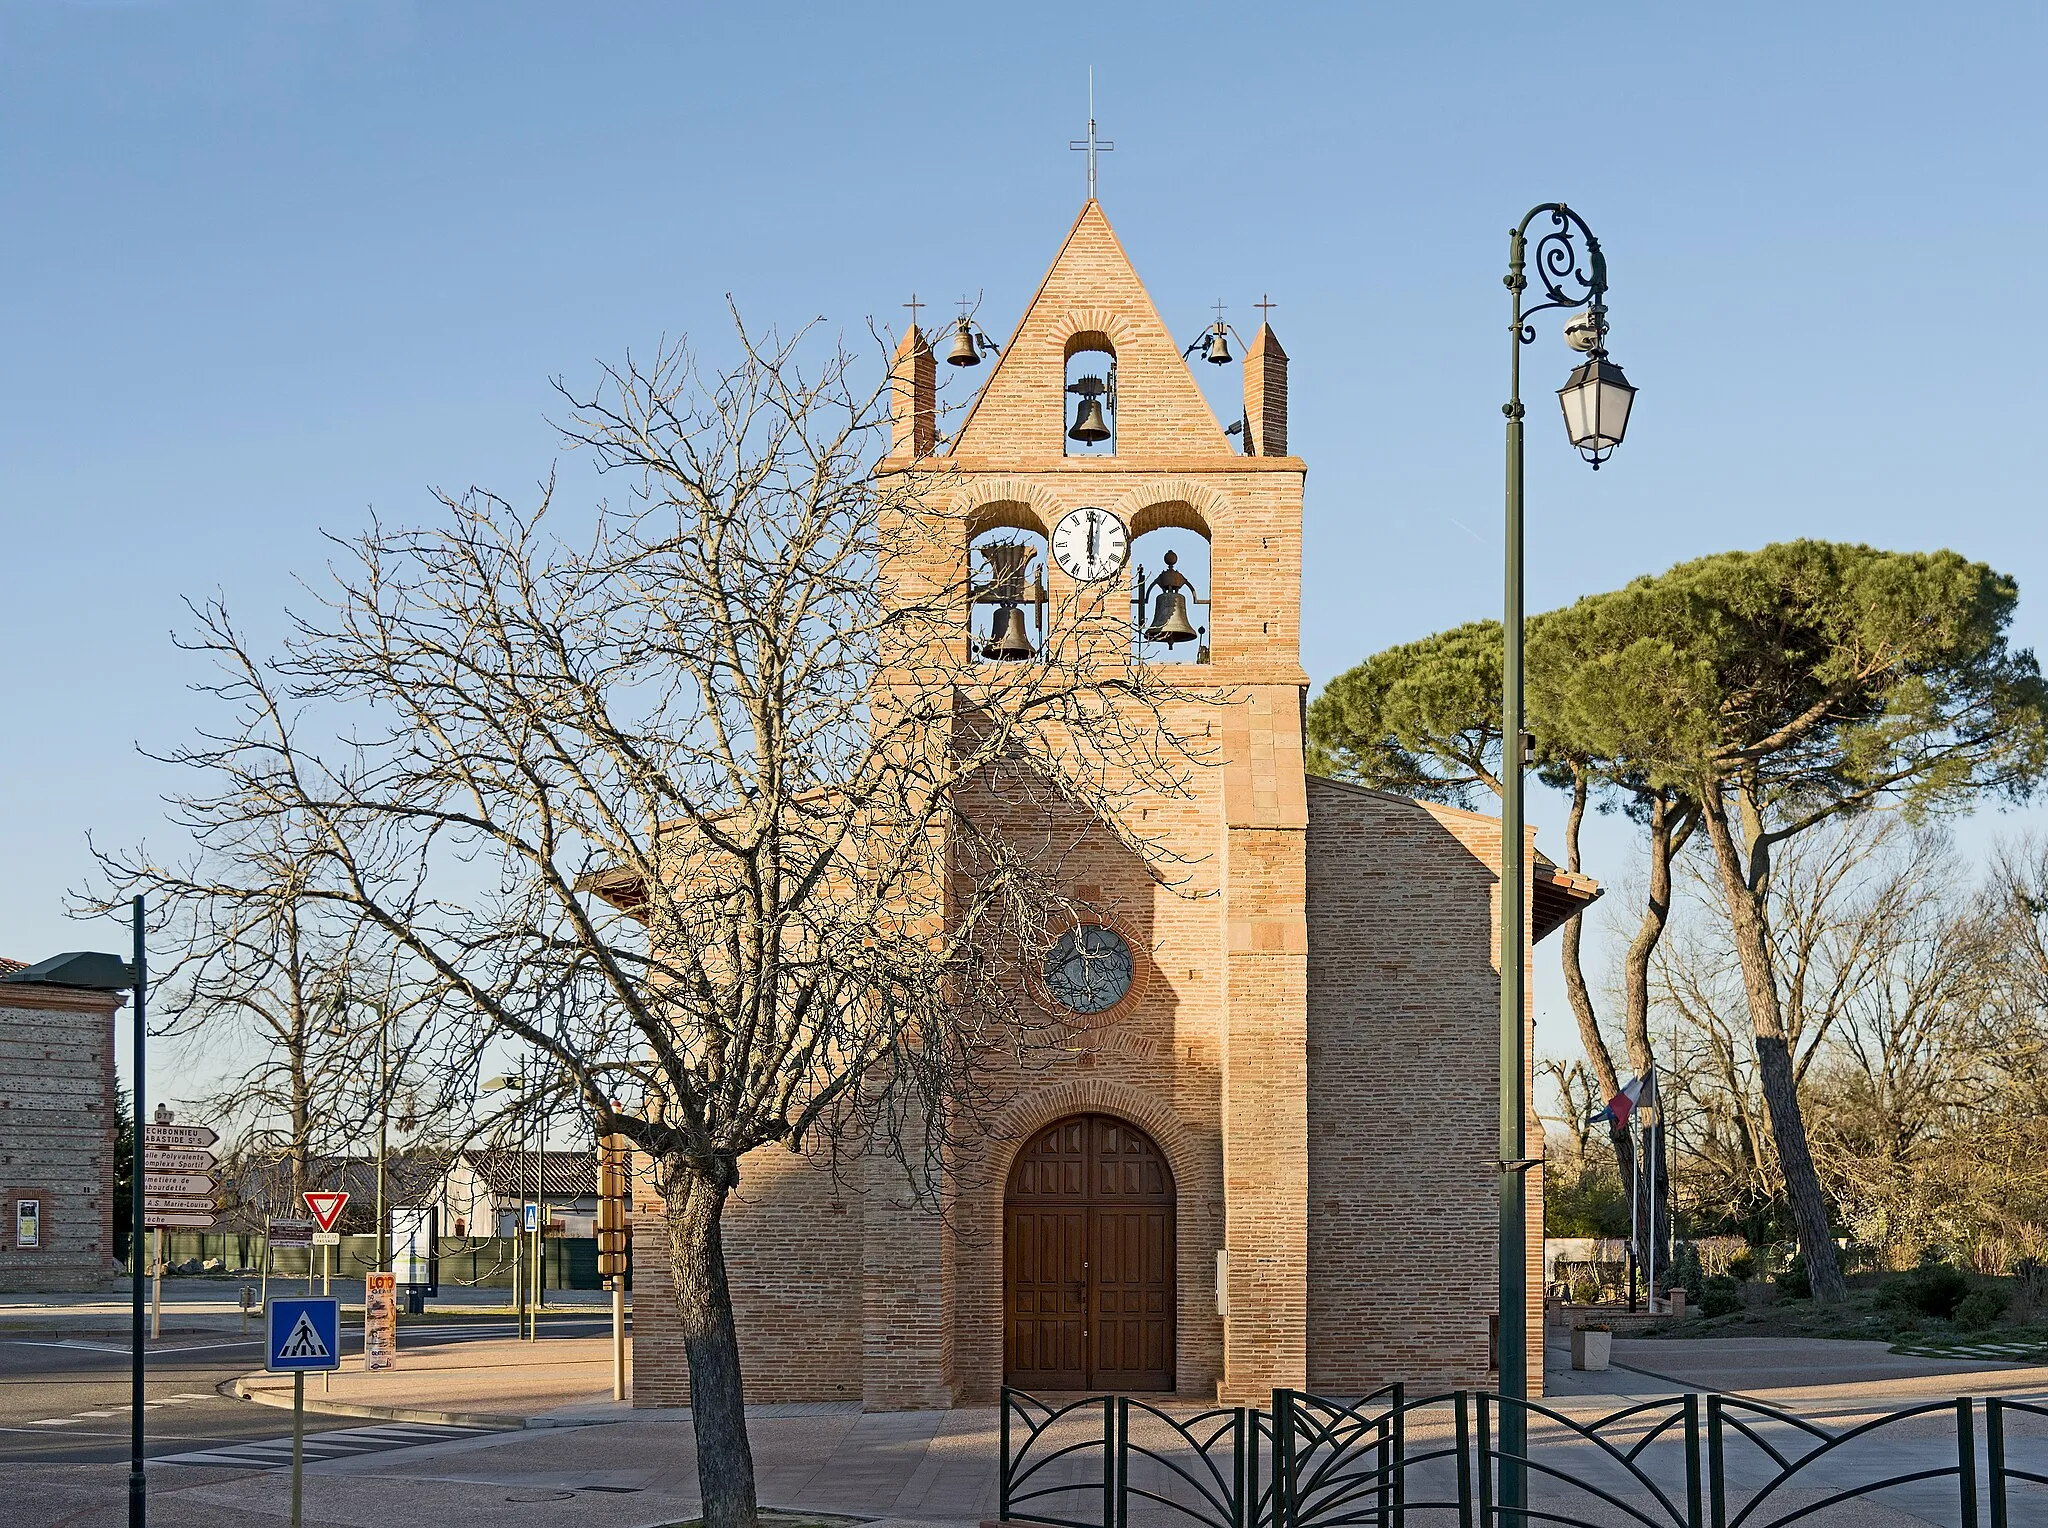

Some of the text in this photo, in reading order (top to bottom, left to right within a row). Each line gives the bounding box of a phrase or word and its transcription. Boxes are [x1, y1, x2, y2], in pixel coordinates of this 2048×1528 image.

[157, 1112, 173, 1120] D77
[146, 1128, 198, 1136] ECHBONNIEU
[161, 1153, 205, 1161] Polyvalente
[178, 1161, 204, 1169] Sportif
